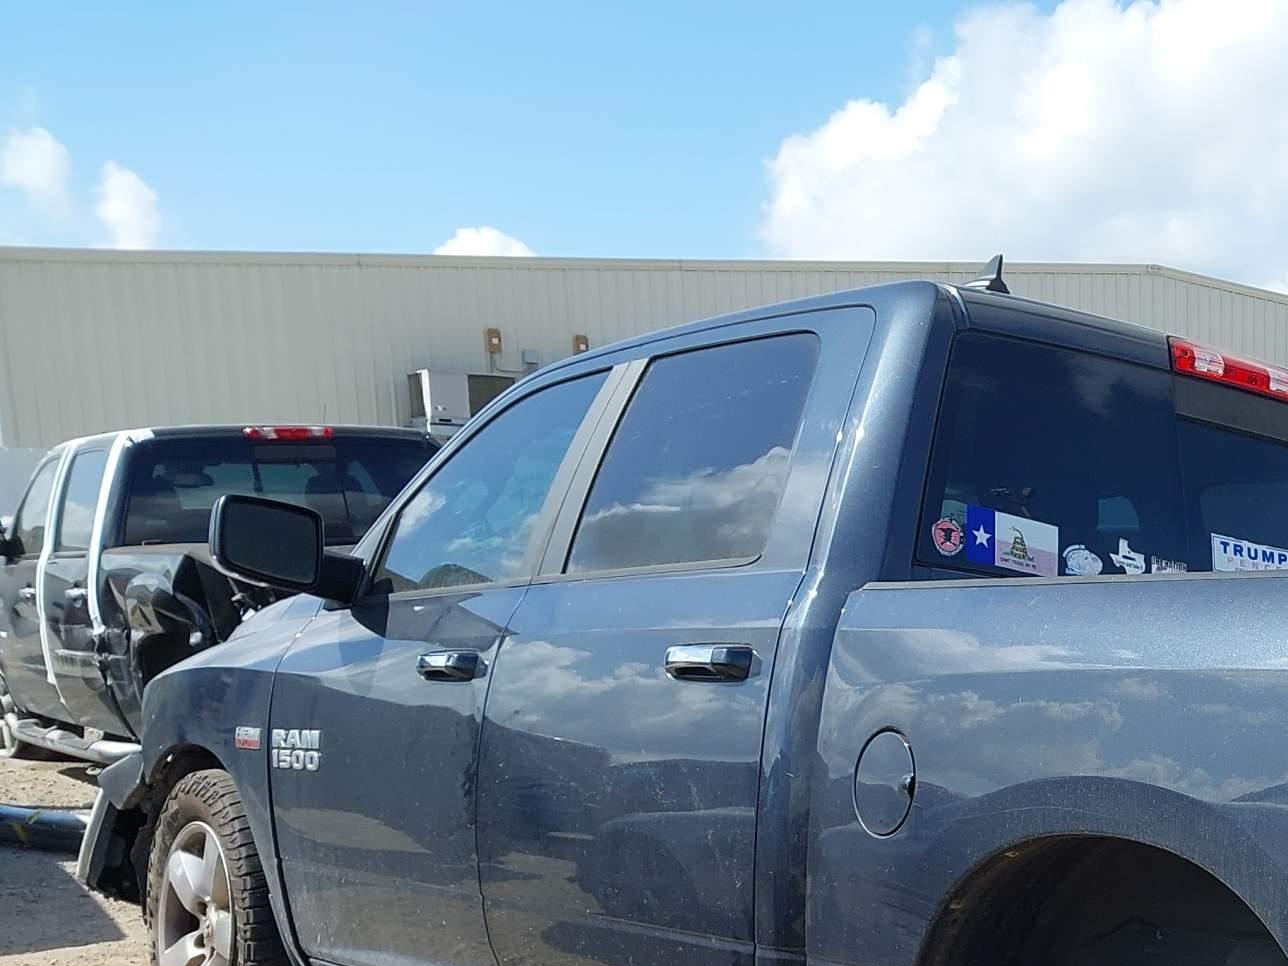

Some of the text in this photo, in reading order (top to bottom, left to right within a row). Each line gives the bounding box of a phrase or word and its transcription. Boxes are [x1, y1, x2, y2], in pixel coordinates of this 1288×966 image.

[1220, 541, 1288, 565] TRUMP
[272, 729, 321, 749] RAM
[272, 749, 321, 771] 1500
